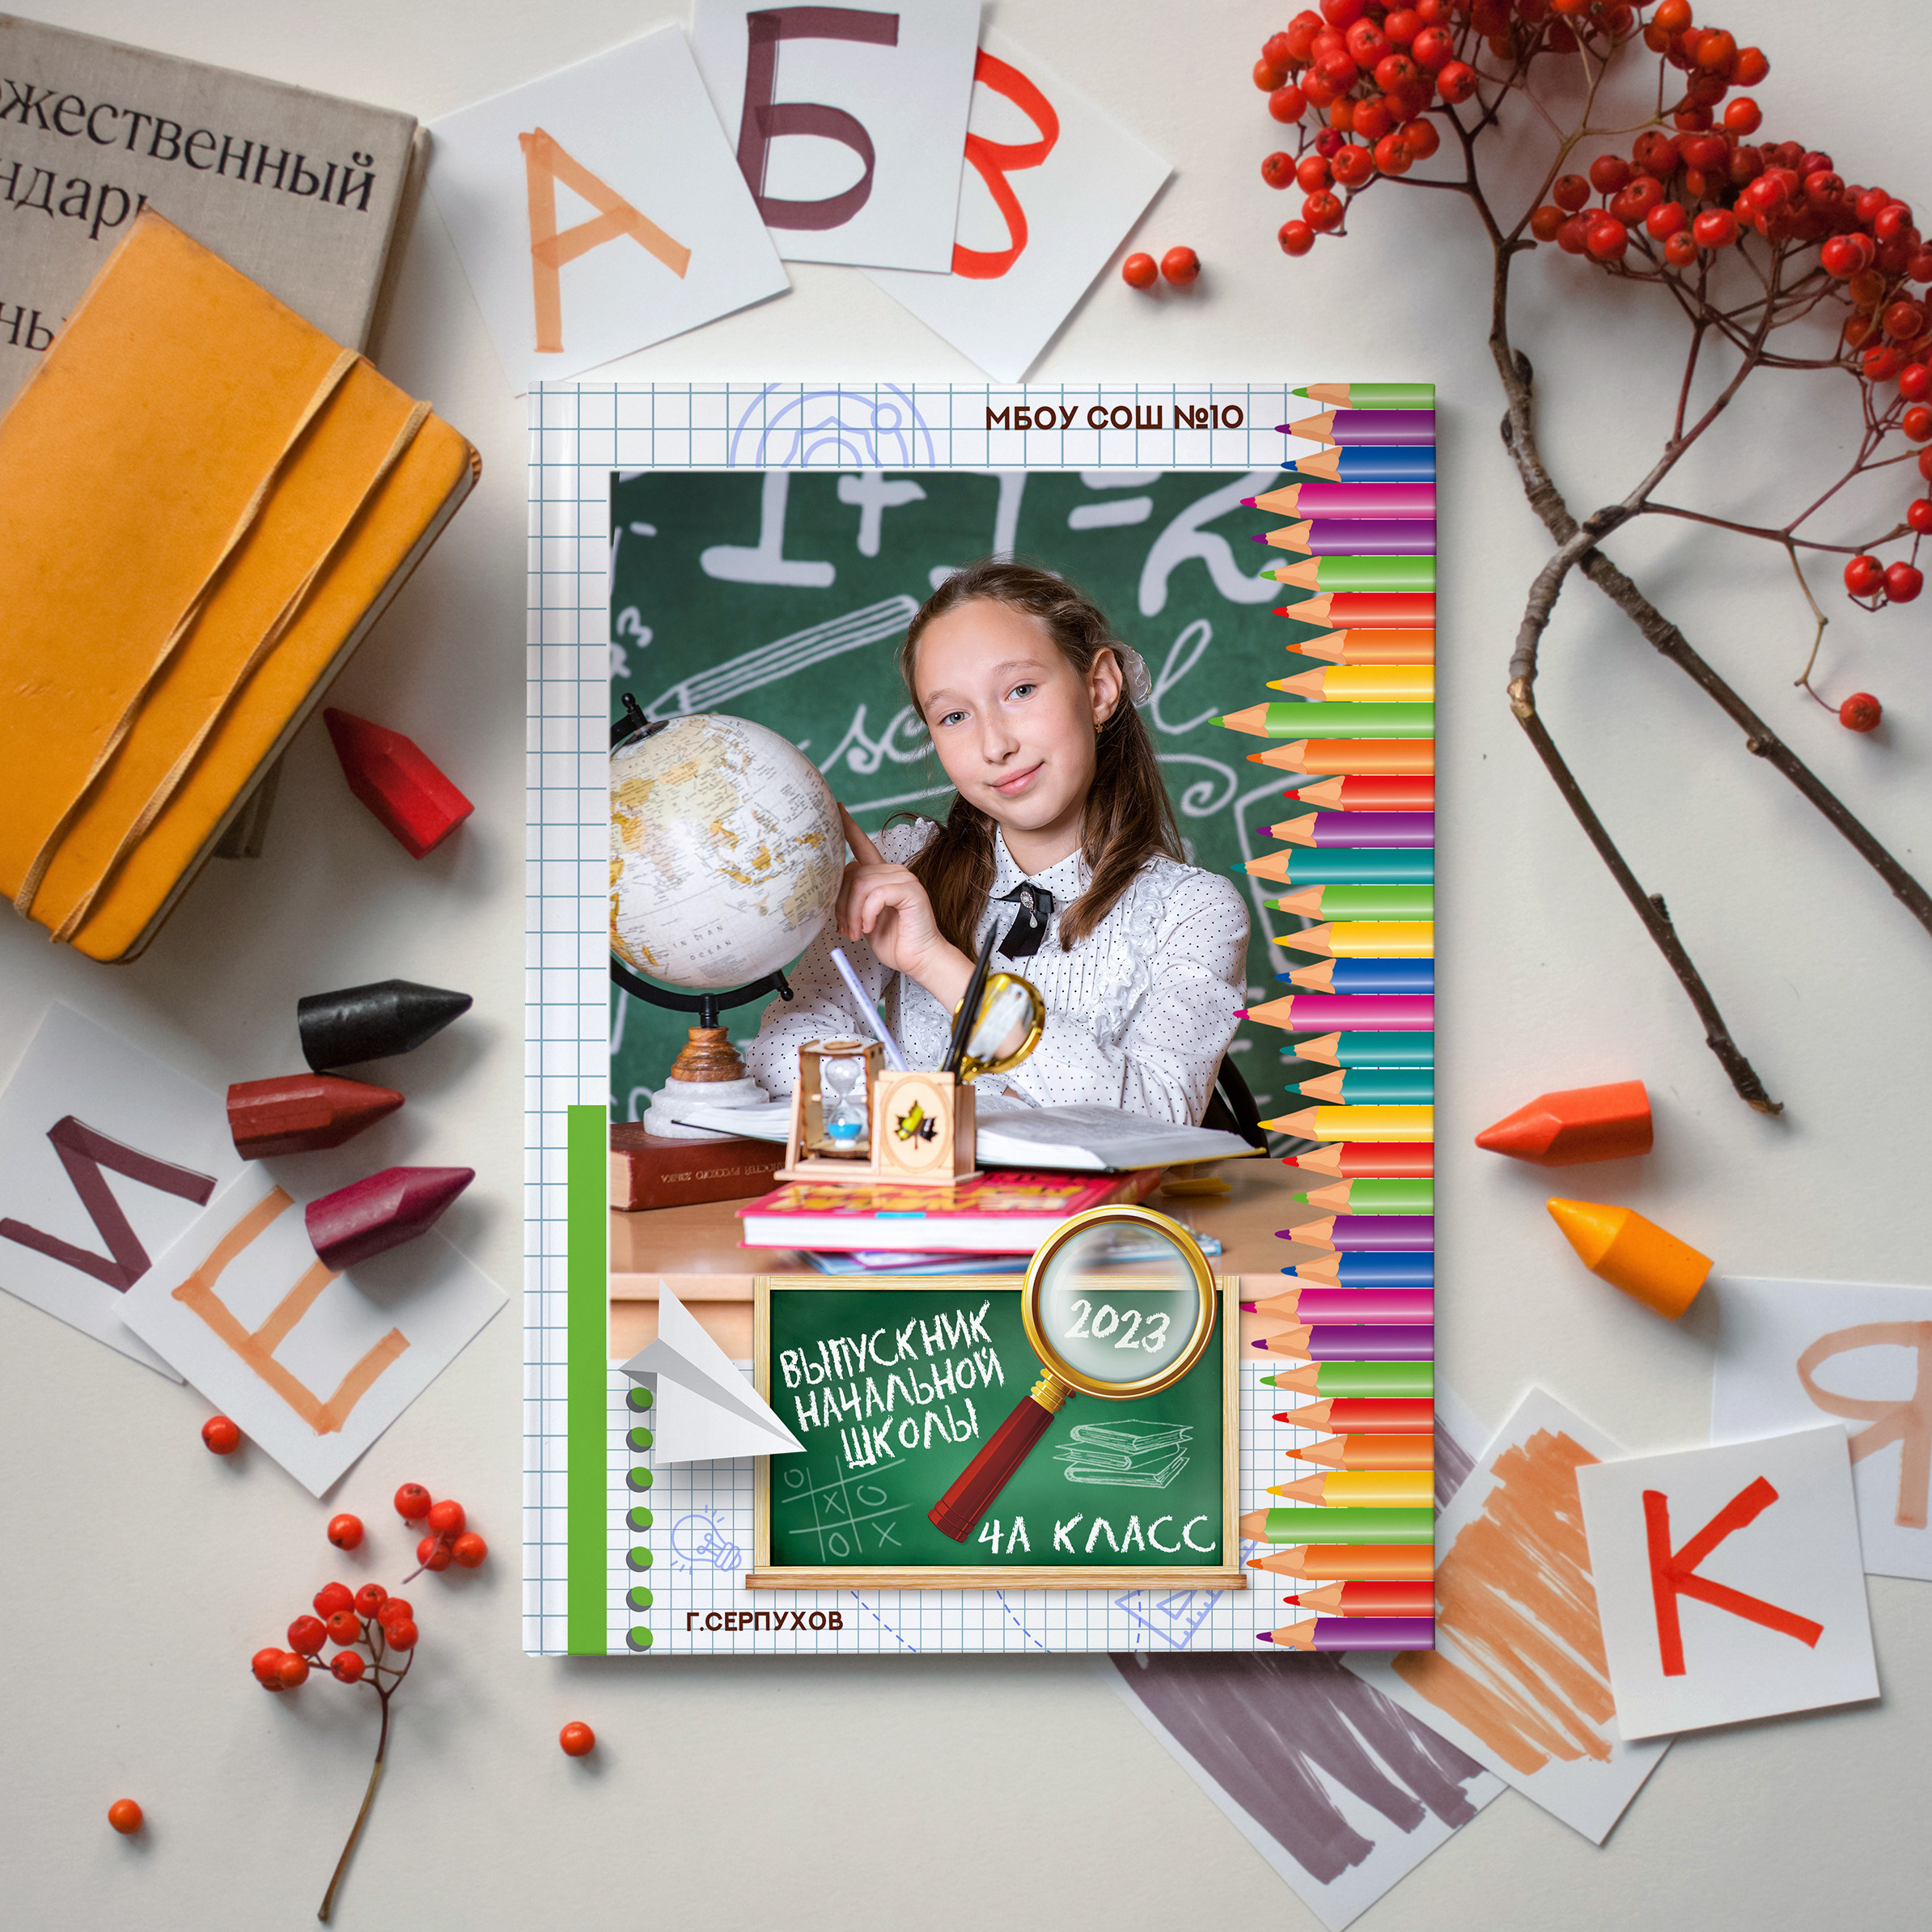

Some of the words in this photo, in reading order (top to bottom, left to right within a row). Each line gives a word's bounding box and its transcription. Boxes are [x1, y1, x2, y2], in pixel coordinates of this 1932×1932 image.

[0, 78, 375, 212] жественный
[736, 5, 900, 231] Б
[0, 159, 148, 241] ндар
[519, 127, 691, 353] А
[985, 405, 1078, 430] МБОУ
[1087, 405, 1163, 430] СОШ
[1174, 405, 1244, 430] №10
[779, 1299, 993, 1389] ВЫПУСКНИК
[1064, 1299, 1171, 1353] 2023
[794, 1346, 1005, 1432] НАЧАЛЬНОЙ
[1796, 1320, 1932, 1530] Я
[841, 1397, 982, 1469] ШКОЛЫ
[977, 1515, 1032, 1555] 4А
[1053, 1511, 1217, 1554] КЛАСС
[1642, 1476, 1824, 1677] К
[686, 1611, 844, 1632] Г.СЕРПУХОВ
